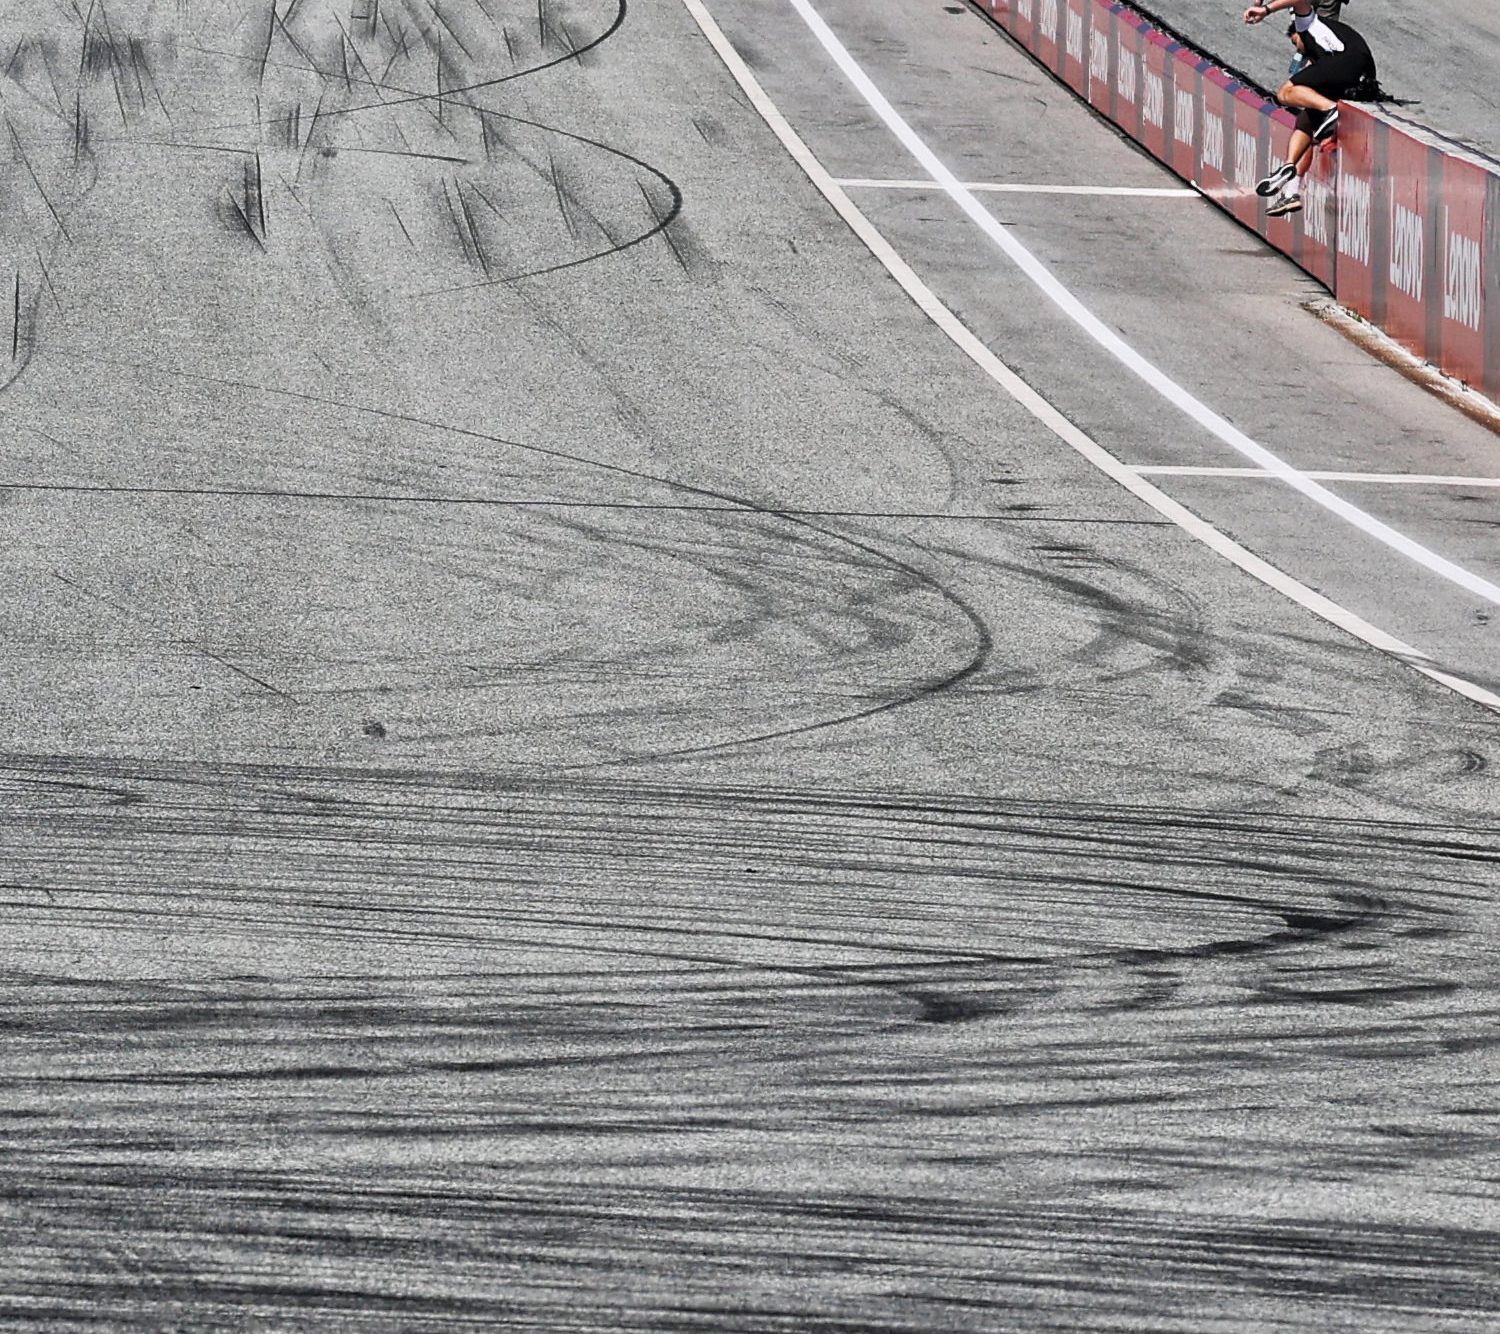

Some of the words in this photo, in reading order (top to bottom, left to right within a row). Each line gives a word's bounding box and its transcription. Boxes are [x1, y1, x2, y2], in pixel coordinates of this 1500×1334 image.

[1338, 147, 1371, 267] Lenovo
[1389, 175, 1424, 303] Lenovo
[1444, 204, 1481, 332] Lenovo
